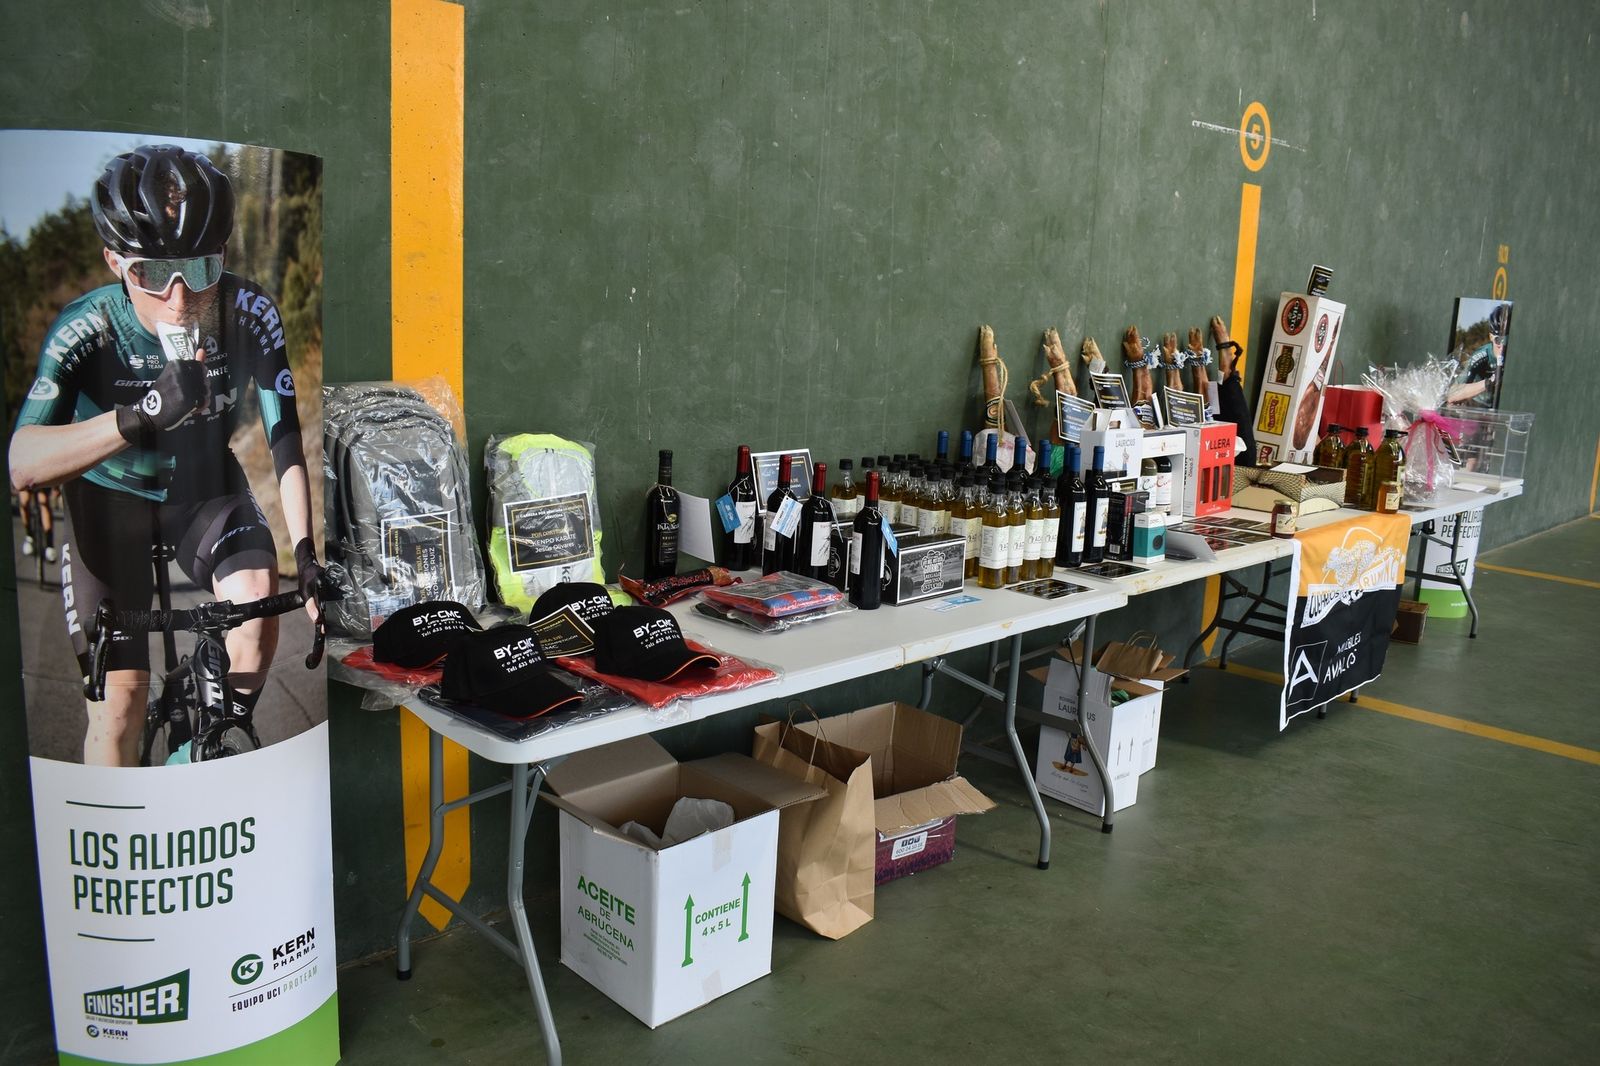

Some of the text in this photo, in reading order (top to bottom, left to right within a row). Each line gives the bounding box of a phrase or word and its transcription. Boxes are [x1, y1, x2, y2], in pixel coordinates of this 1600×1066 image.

[1250, 123, 1261, 151] 5
[235, 288, 287, 351] KERN
[45, 312, 110, 363] KERN
[1205, 438, 1231, 451] YLLERA
[532, 533, 577, 547] KENPO KARATE
[62, 543, 81, 636] KERN
[412, 610, 462, 627] BY-CMC
[633, 618, 675, 639] BY-CMC
[1288, 649, 1319, 701] A
[69, 816, 256, 871] LOS ALIADOS
[73, 867, 234, 916] PERFECTOS
[577, 875, 636, 926] ACEITE
[577, 905, 635, 951] ABRUCENA
[599, 907, 612, 921] DE
[695, 898, 741, 925] CONTIENE
[702, 925, 708, 937] 4
[718, 921, 724, 932] 5
[725, 918, 731, 928] L
[272, 927, 315, 961] KERN
[273, 943, 316, 971] PHARMA
[85, 982, 180, 1016] FINISHER
[232, 965, 318, 1012] EQUIPO UCI PROTEAM
[102, 1028, 129, 1037] KERN
